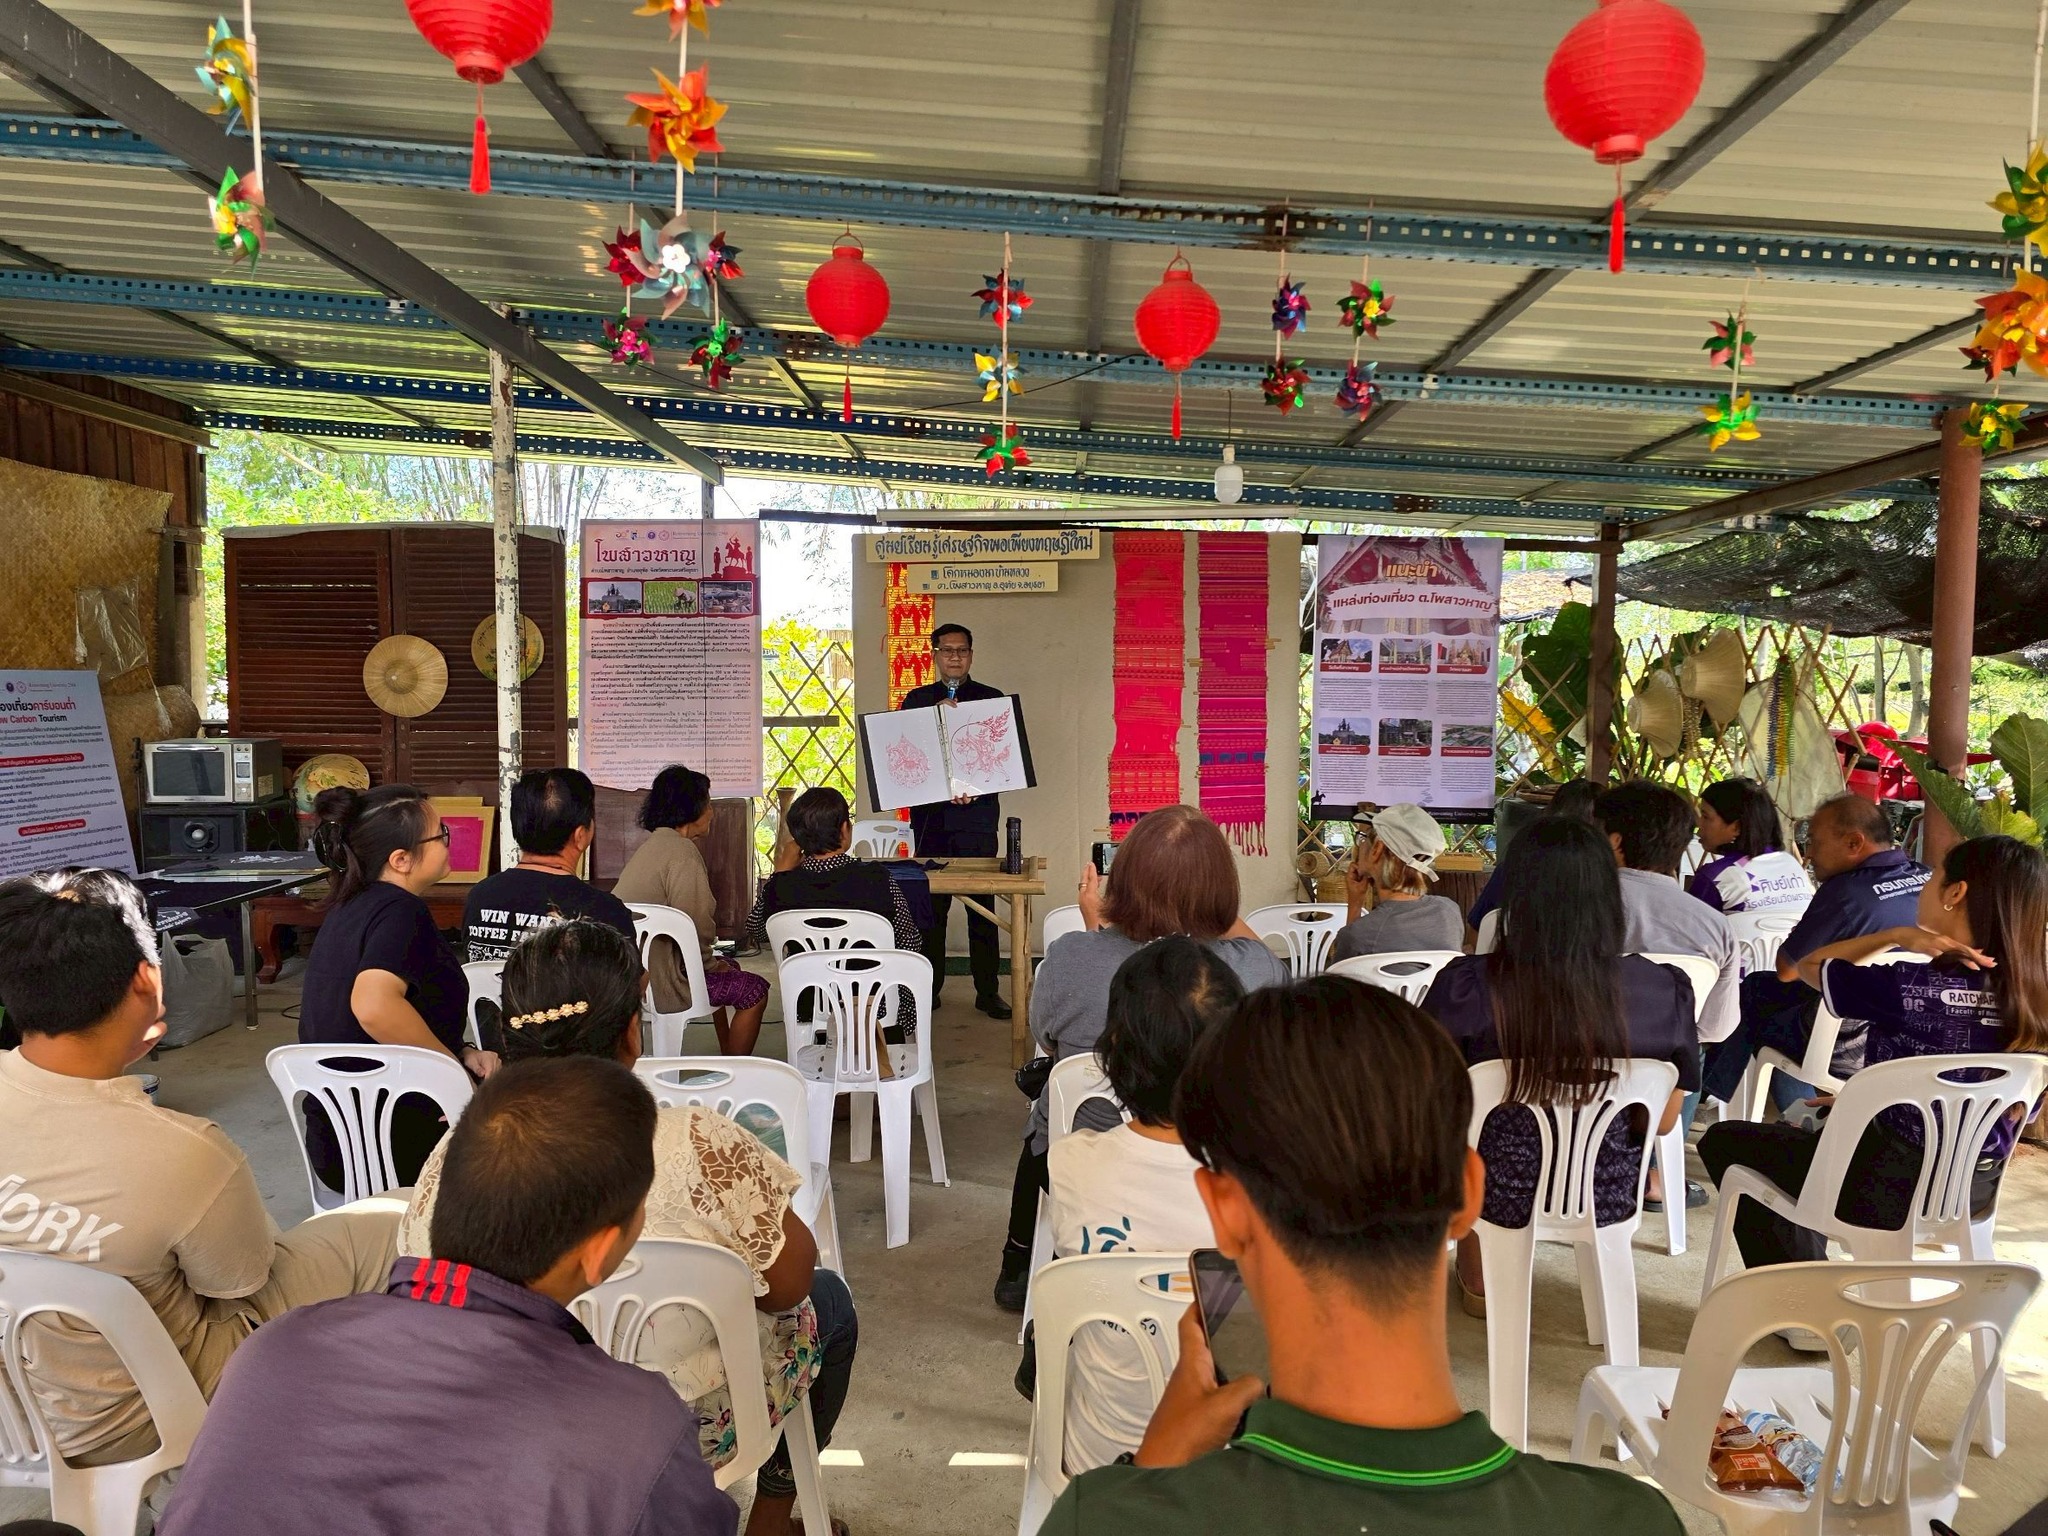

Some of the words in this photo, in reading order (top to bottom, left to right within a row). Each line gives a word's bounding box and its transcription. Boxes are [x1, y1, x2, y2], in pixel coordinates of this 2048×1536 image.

[595, 539, 696, 565] โพสาวหาญ
[1385, 560, 1438, 578] แนะนำ
[1333, 588, 1415, 609] แหล่งท่องเที่ยว
[1418, 591, 1493, 612] ต.โพสาวหาญ
[10, 715, 37, 724] Carbon
[38, 714, 67, 723] Tourism
[1759, 873, 1805, 893] ศิษย์เก่า
[480, 908, 510, 924] WIN
[1949, 992, 1996, 1006] RATCHAP
